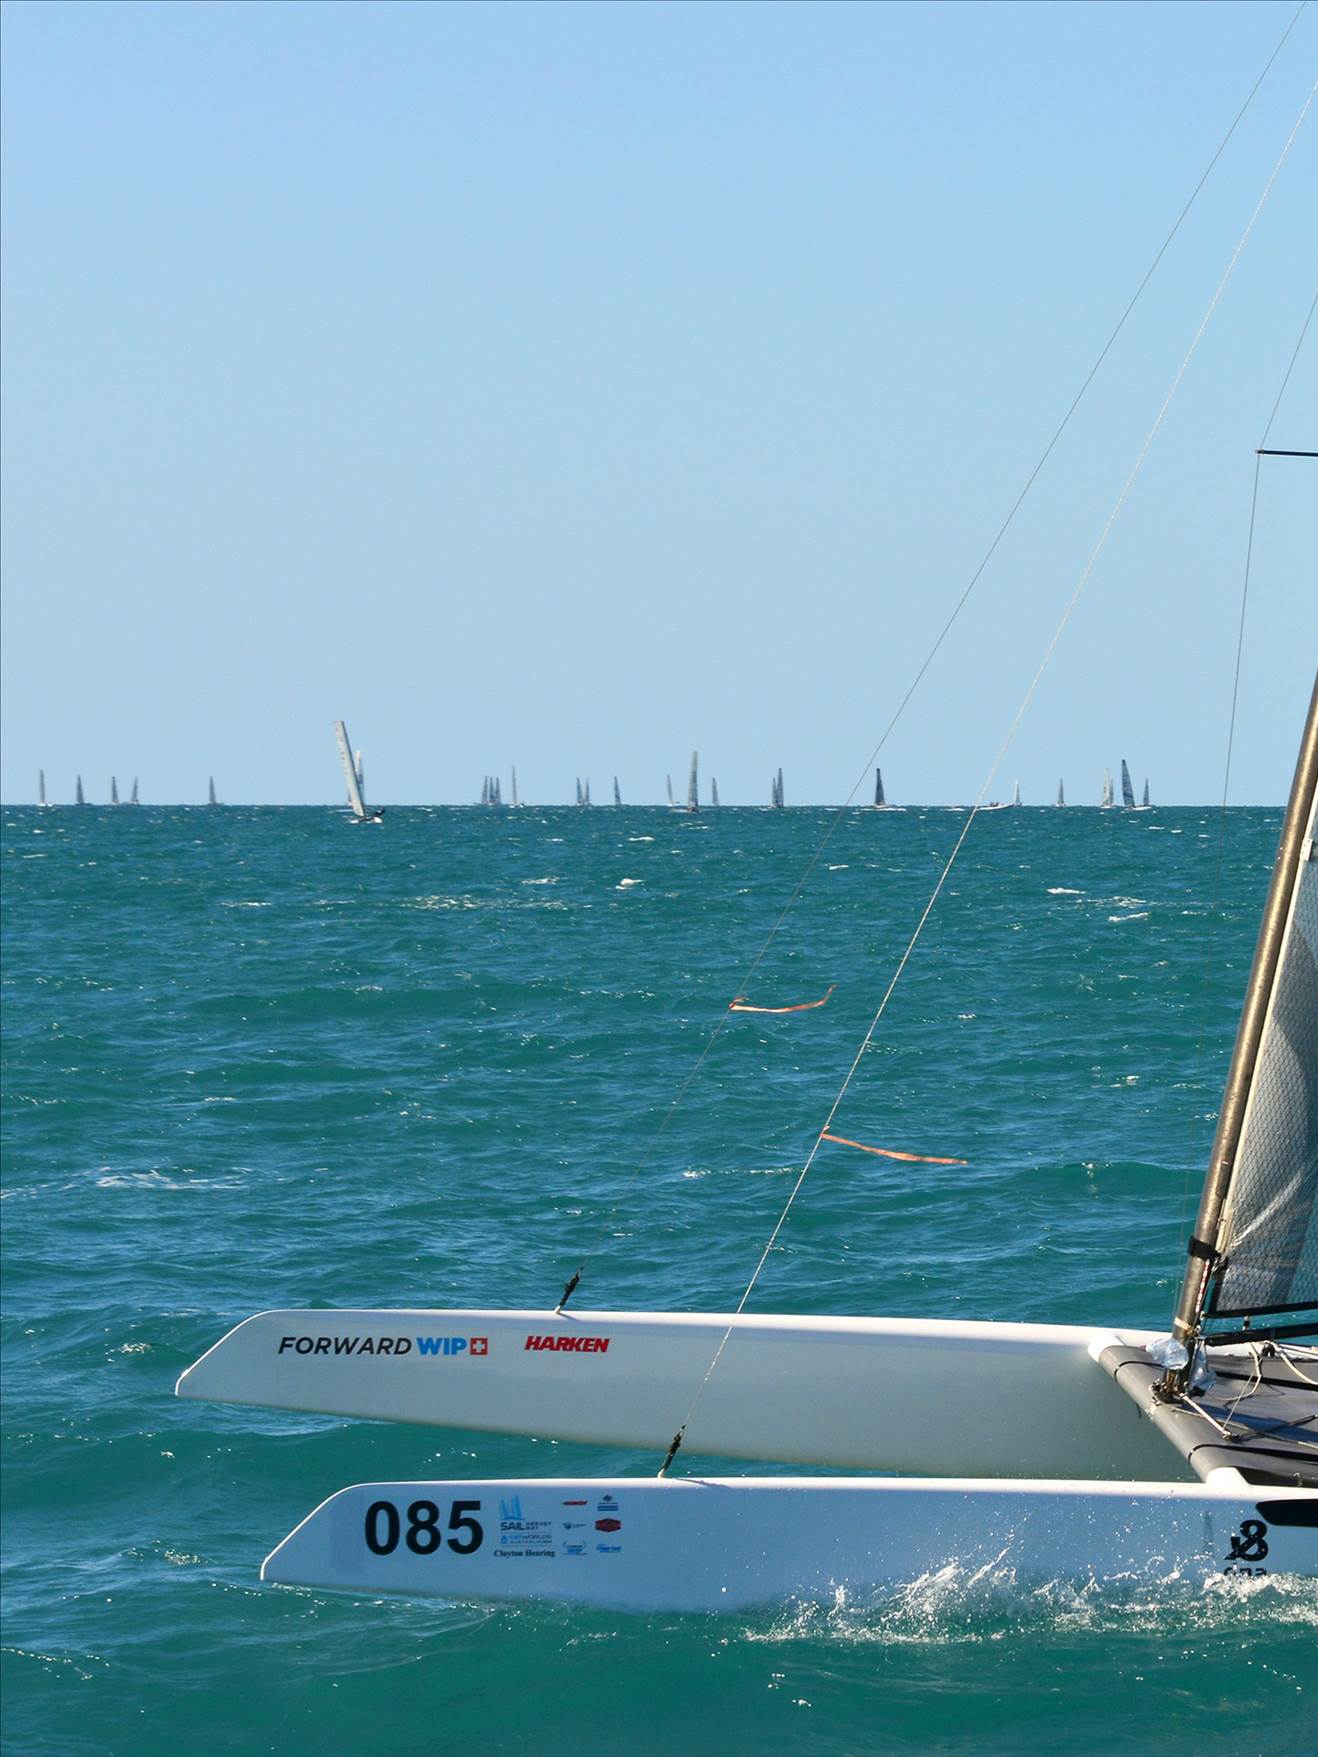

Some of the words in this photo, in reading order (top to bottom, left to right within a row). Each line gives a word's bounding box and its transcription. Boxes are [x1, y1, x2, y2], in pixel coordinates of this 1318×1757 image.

[278, 1336, 412, 1355] FORWARD
[416, 1337, 468, 1355] WIP
[524, 1335, 610, 1353] HARKEN
[364, 1500, 484, 1556] 085
[500, 1521, 525, 1531] SAIL
